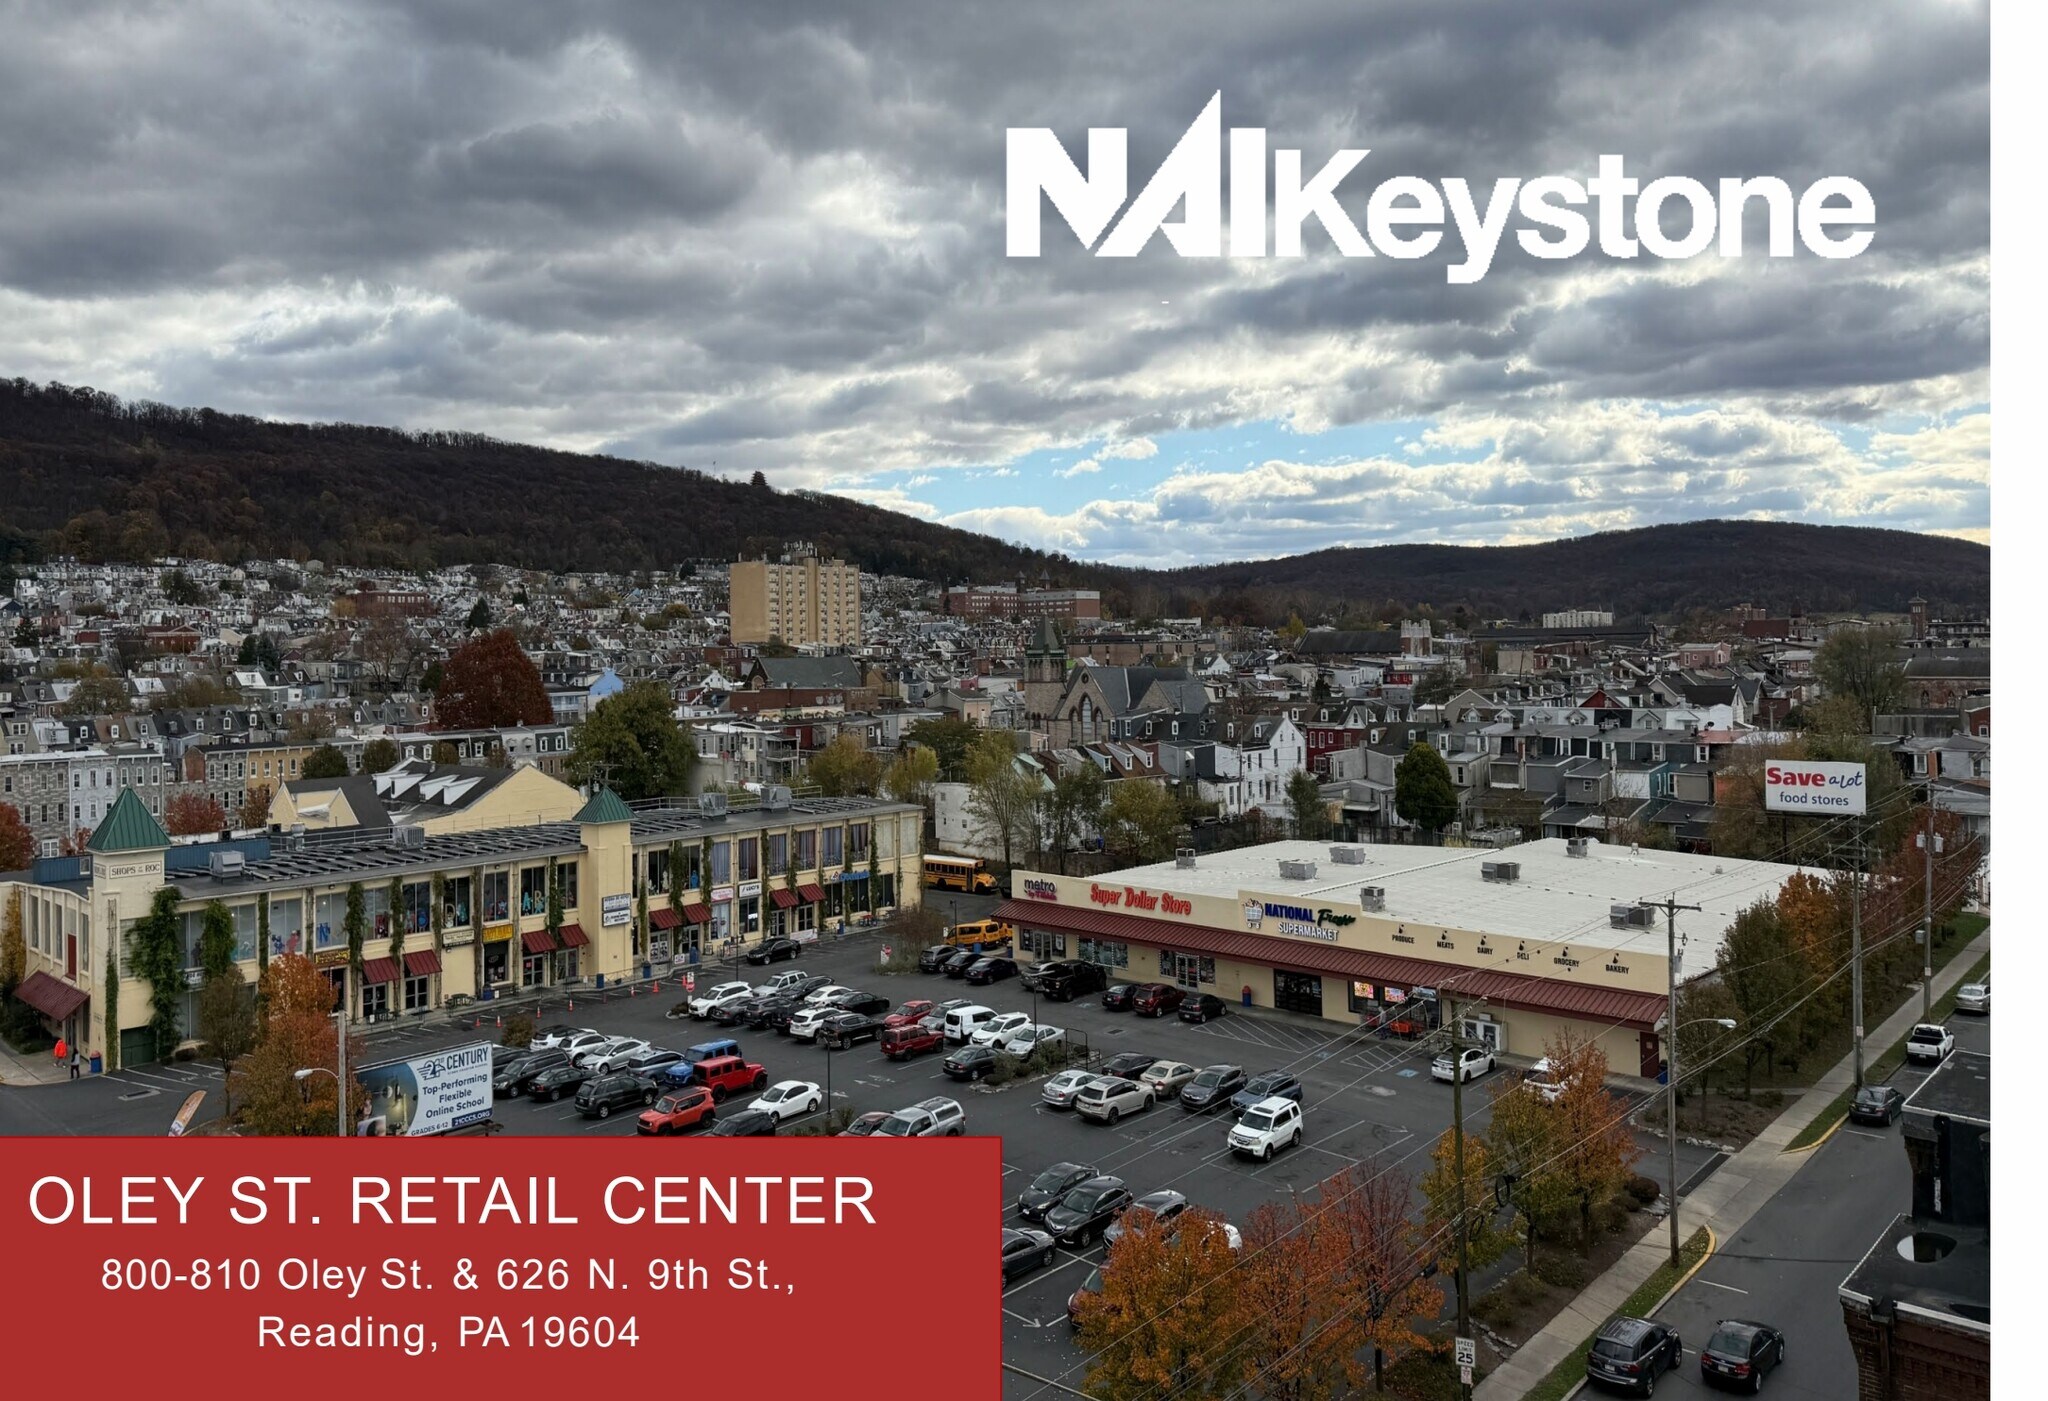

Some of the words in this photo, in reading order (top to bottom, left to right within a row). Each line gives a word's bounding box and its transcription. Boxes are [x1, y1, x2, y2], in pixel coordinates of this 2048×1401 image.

[1767, 767, 1826, 787] Save
[1780, 791, 1808, 804] food
[1811, 795, 1849, 806] stores
[111, 866, 136, 876] SHOPS
[1024, 879, 1056, 893] metro
[1090, 883, 1122, 907] Super
[1124, 887, 1158, 910] Dollar
[1161, 892, 1192, 915] Store
[1265, 903, 1316, 923] NATIONAL
[1278, 922, 1339, 941] SUPERMARKET
[1392, 934, 1415, 944] PRODUCE
[1437, 940, 1454, 950] MEATS
[1477, 946, 1493, 955] DAIRY
[1554, 957, 1580, 967] GROCERY
[1606, 964, 1630, 974] BAKERY
[446, 1047, 489, 1070] CENTURY
[422, 1074, 488, 1095] Top-Performing
[439, 1089, 472, 1103] Flexible
[426, 1106, 454, 1118] Online
[456, 1096, 485, 1111] School
[411, 1125, 436, 1136] GRADES
[1457, 1352, 1474, 1364] 25
